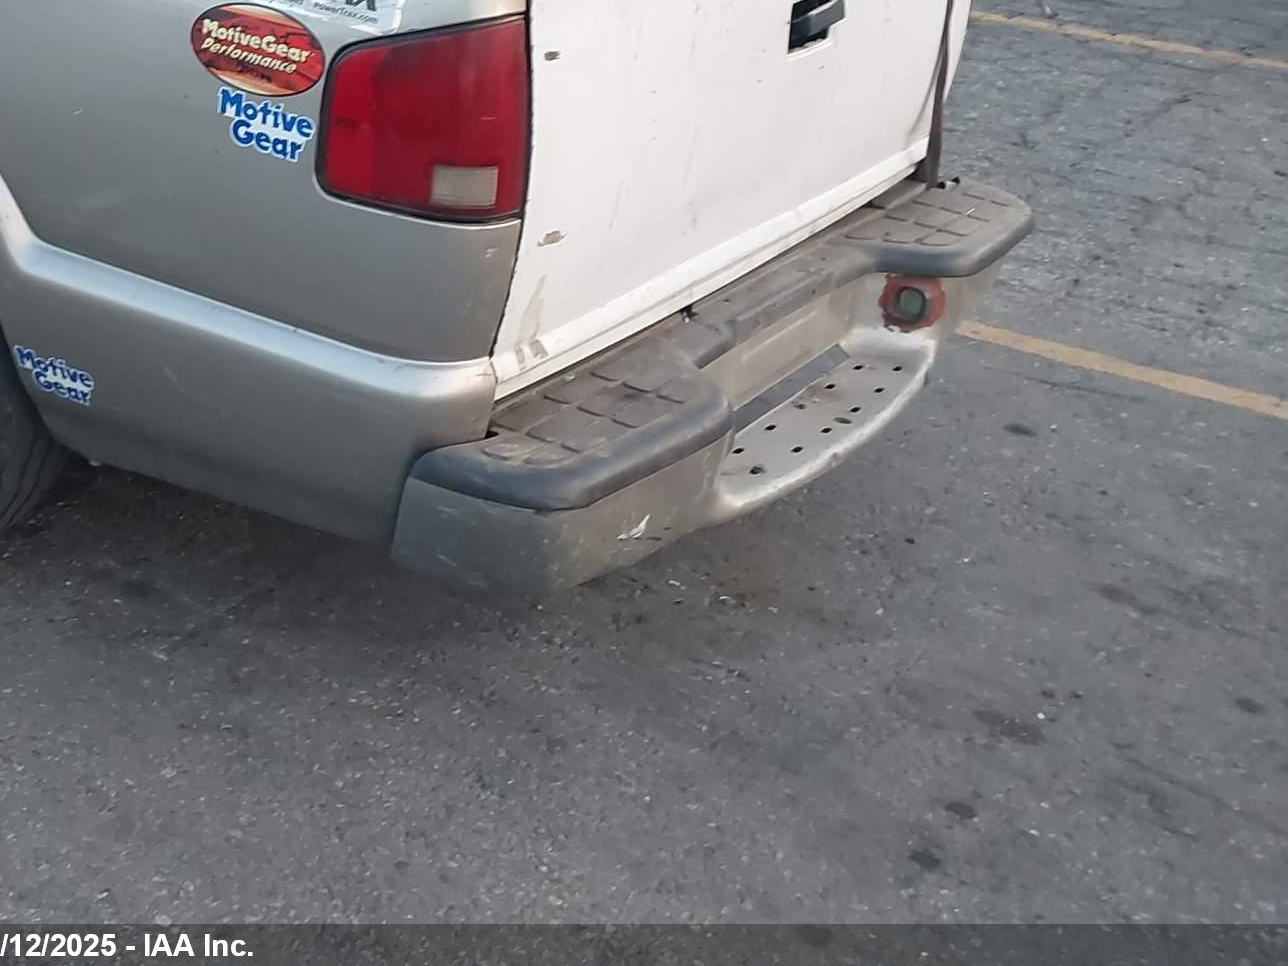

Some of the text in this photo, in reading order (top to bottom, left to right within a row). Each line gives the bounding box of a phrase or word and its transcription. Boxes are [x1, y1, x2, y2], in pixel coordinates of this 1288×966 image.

[200, 37, 297, 74] Performance
[202, 18, 310, 62] MotiveGear
[220, 88, 313, 138] Motive
[232, 119, 303, 160] Gear
[15, 347, 93, 387] Motive
[34, 370, 88, 402] Gear
